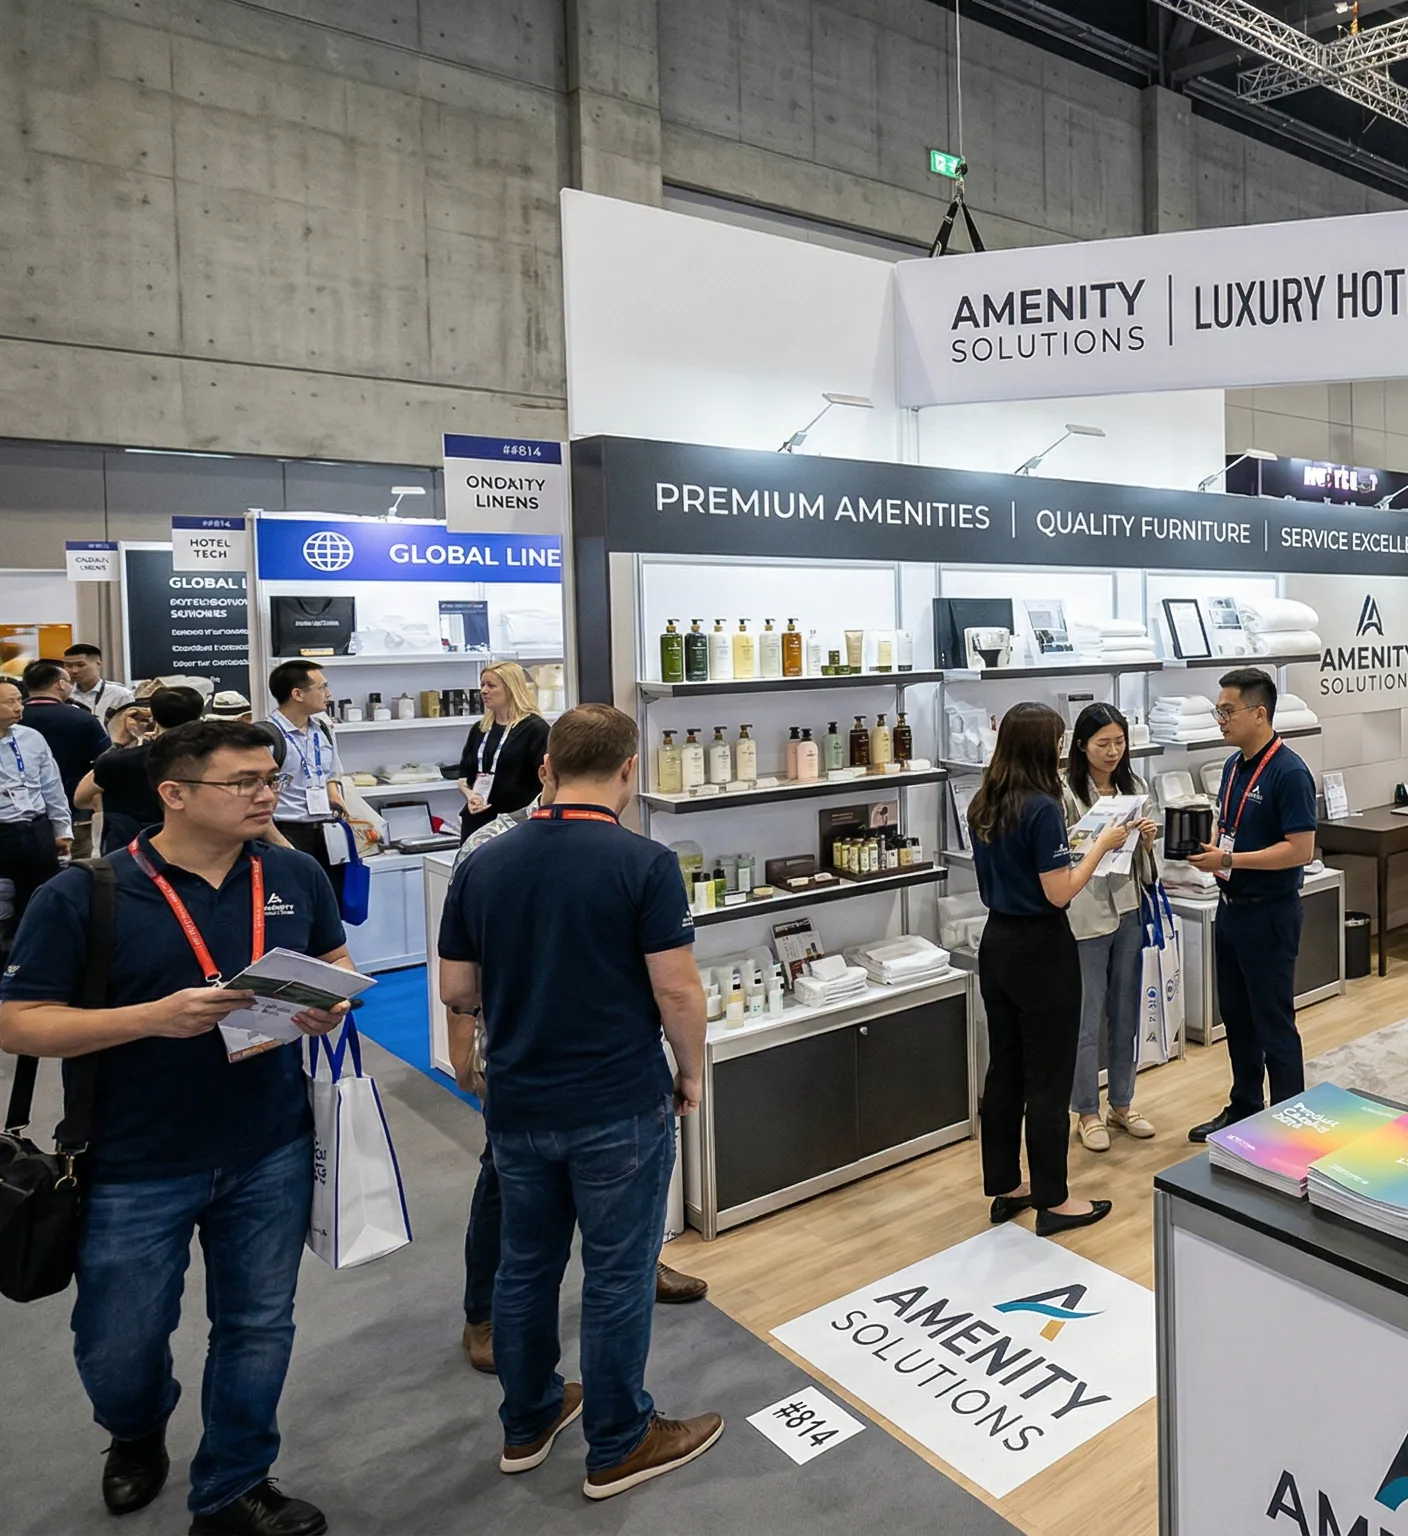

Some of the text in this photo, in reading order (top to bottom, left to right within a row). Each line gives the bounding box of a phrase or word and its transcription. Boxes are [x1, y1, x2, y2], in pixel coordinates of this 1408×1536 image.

[951, 279, 1146, 330] AMENITY
[1194, 275, 1326, 330] LUXURY
[951, 325, 1146, 364] SOLUTIONS
[476, 494, 539, 509] LINENS
[655, 481, 991, 529] PREMIUM AMENITIES
[190, 538, 231, 547] HOTEL
[1036, 510, 1251, 544] QUALITY FURNITURE
[1281, 527, 1348, 550] SERVICE
[193, 549, 227, 558] TECH
[389, 544, 499, 566] GLOBAL
[169, 577, 239, 589] GLOBAL
[873, 1285, 1112, 1419] AMENITY
[831, 1310, 1045, 1451] SOLUTIONS
[772, 1401, 840, 1446] #814
